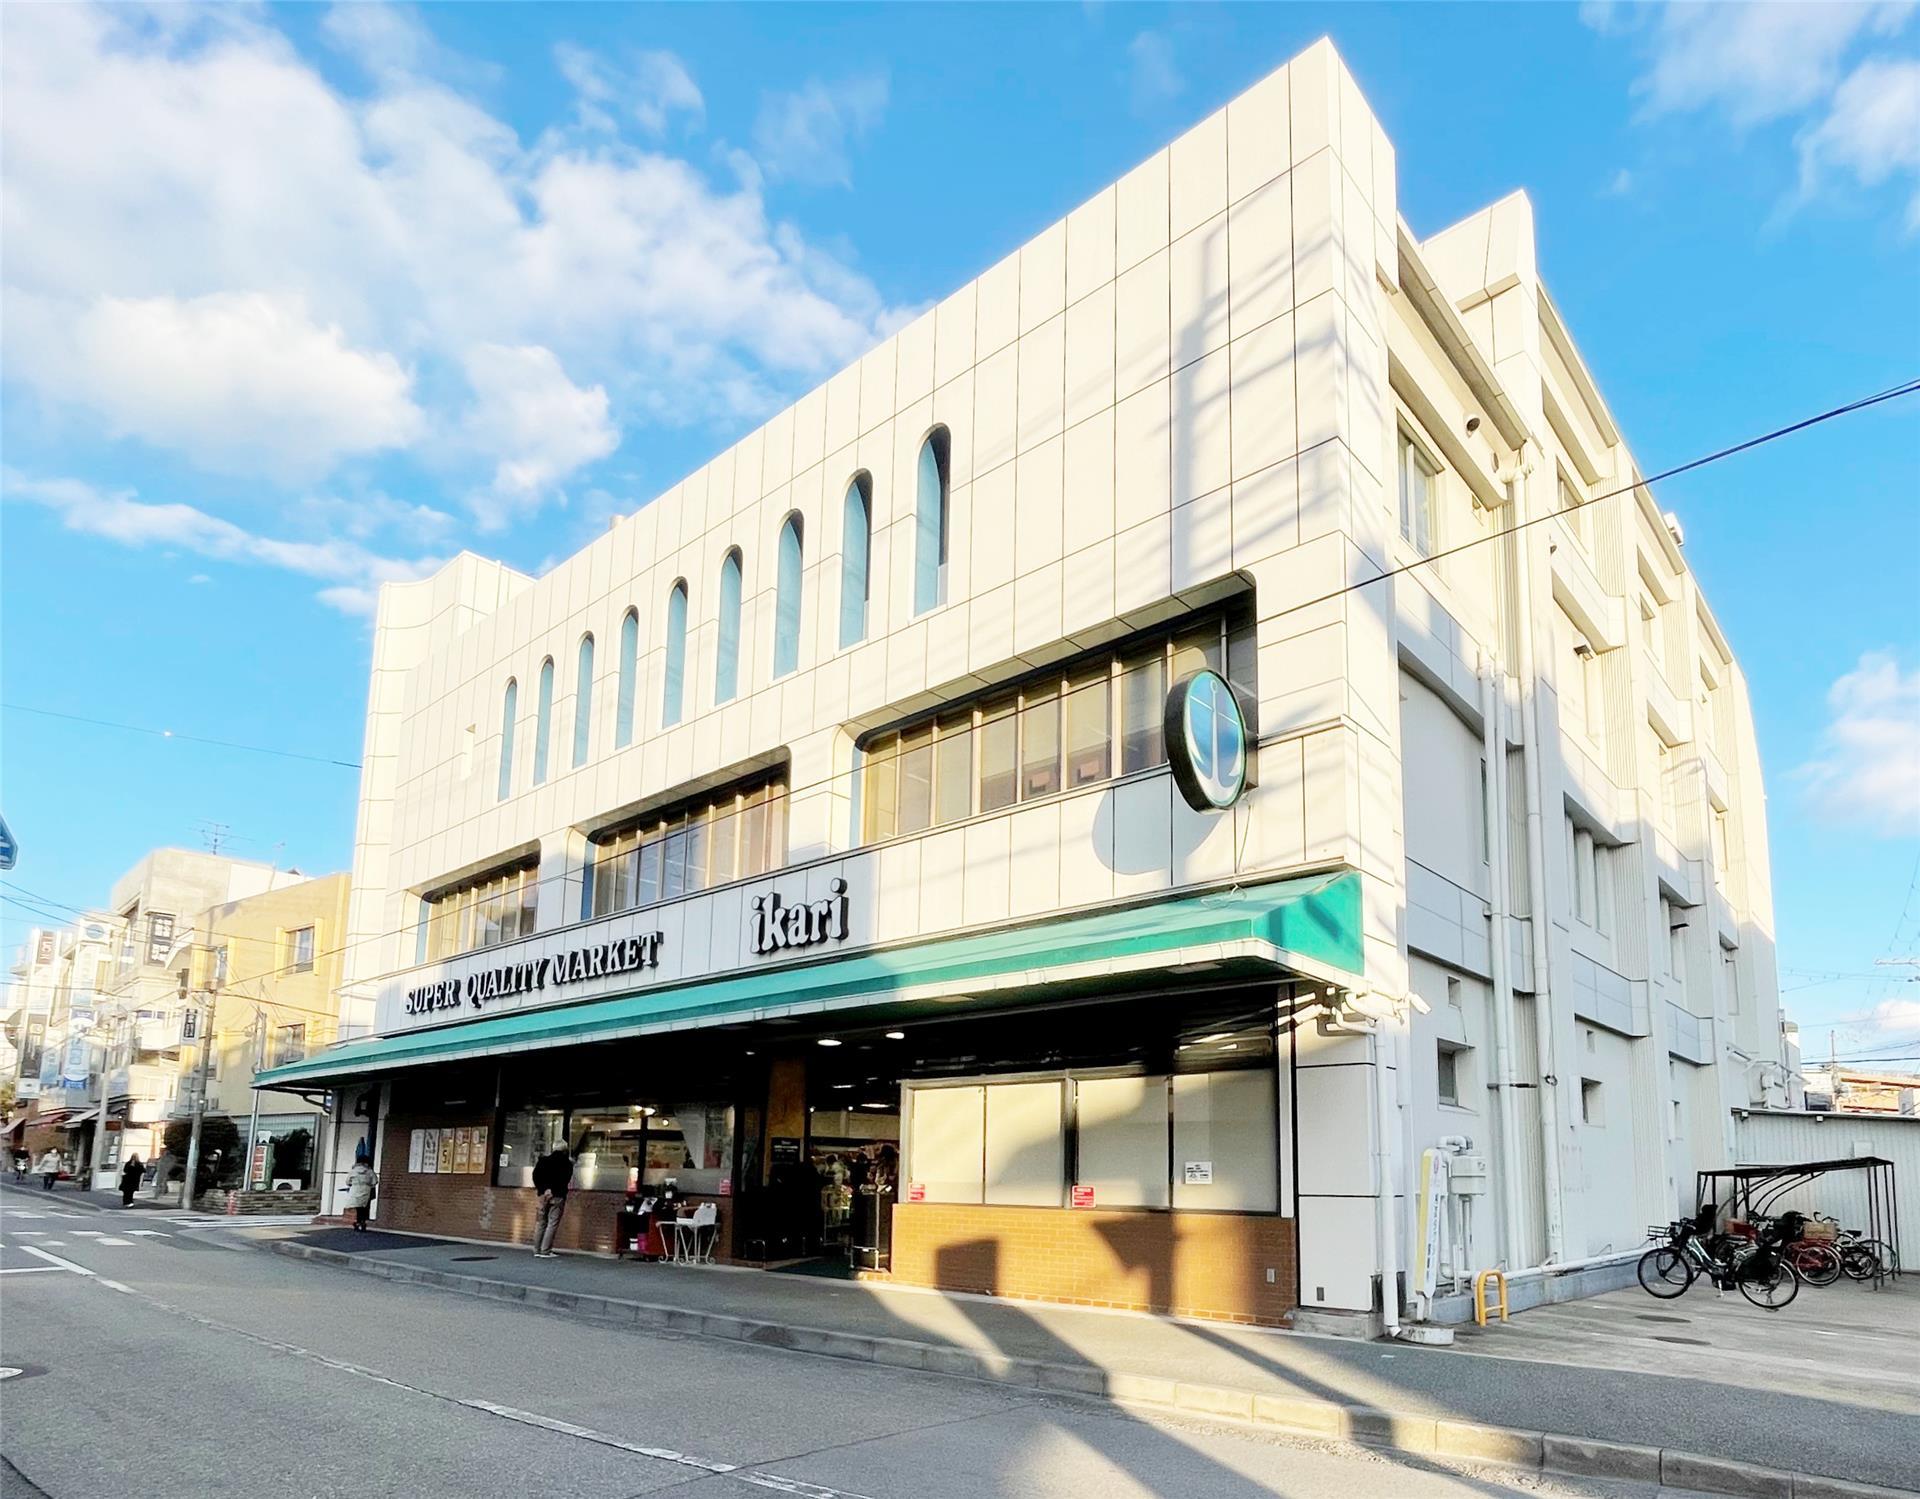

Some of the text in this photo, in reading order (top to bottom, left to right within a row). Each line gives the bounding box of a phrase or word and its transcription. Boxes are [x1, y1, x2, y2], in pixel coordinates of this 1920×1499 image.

[750, 878, 849, 954] ikari
[405, 931, 663, 1014] SUPER QUALITY MARKET
